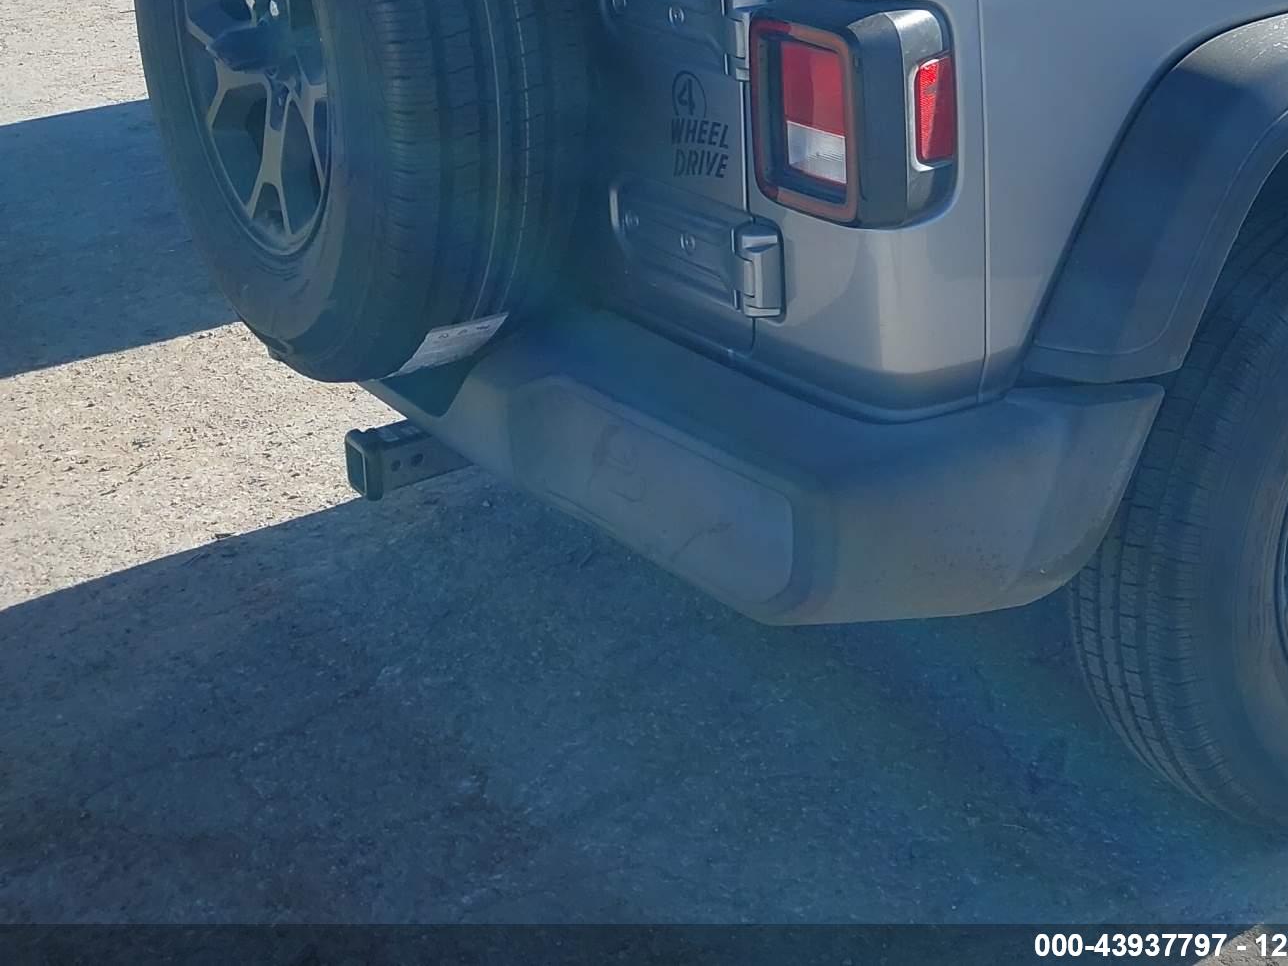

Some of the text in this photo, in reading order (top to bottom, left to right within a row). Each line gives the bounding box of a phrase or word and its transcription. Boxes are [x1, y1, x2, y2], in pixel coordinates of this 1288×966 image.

[677, 77, 697, 116] 4
[671, 117, 729, 150] WHEEL
[673, 148, 729, 179] DRIVE
